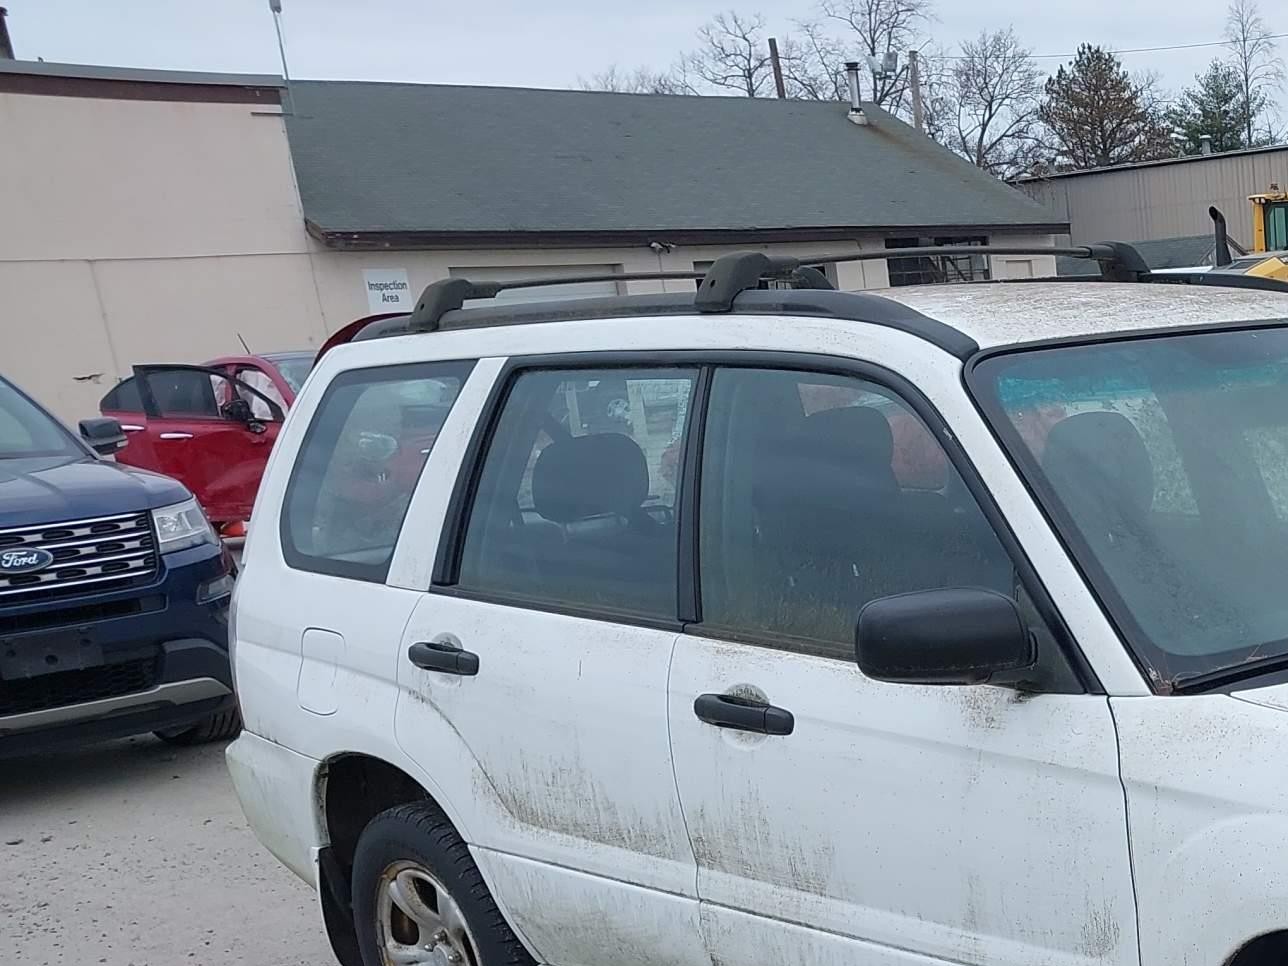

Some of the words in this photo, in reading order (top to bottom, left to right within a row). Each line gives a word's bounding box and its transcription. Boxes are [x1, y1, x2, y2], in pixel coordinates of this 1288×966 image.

[368, 281, 408, 291] Inspection
[382, 294, 399, 303] Area
[2, 552, 39, 567] Ford
